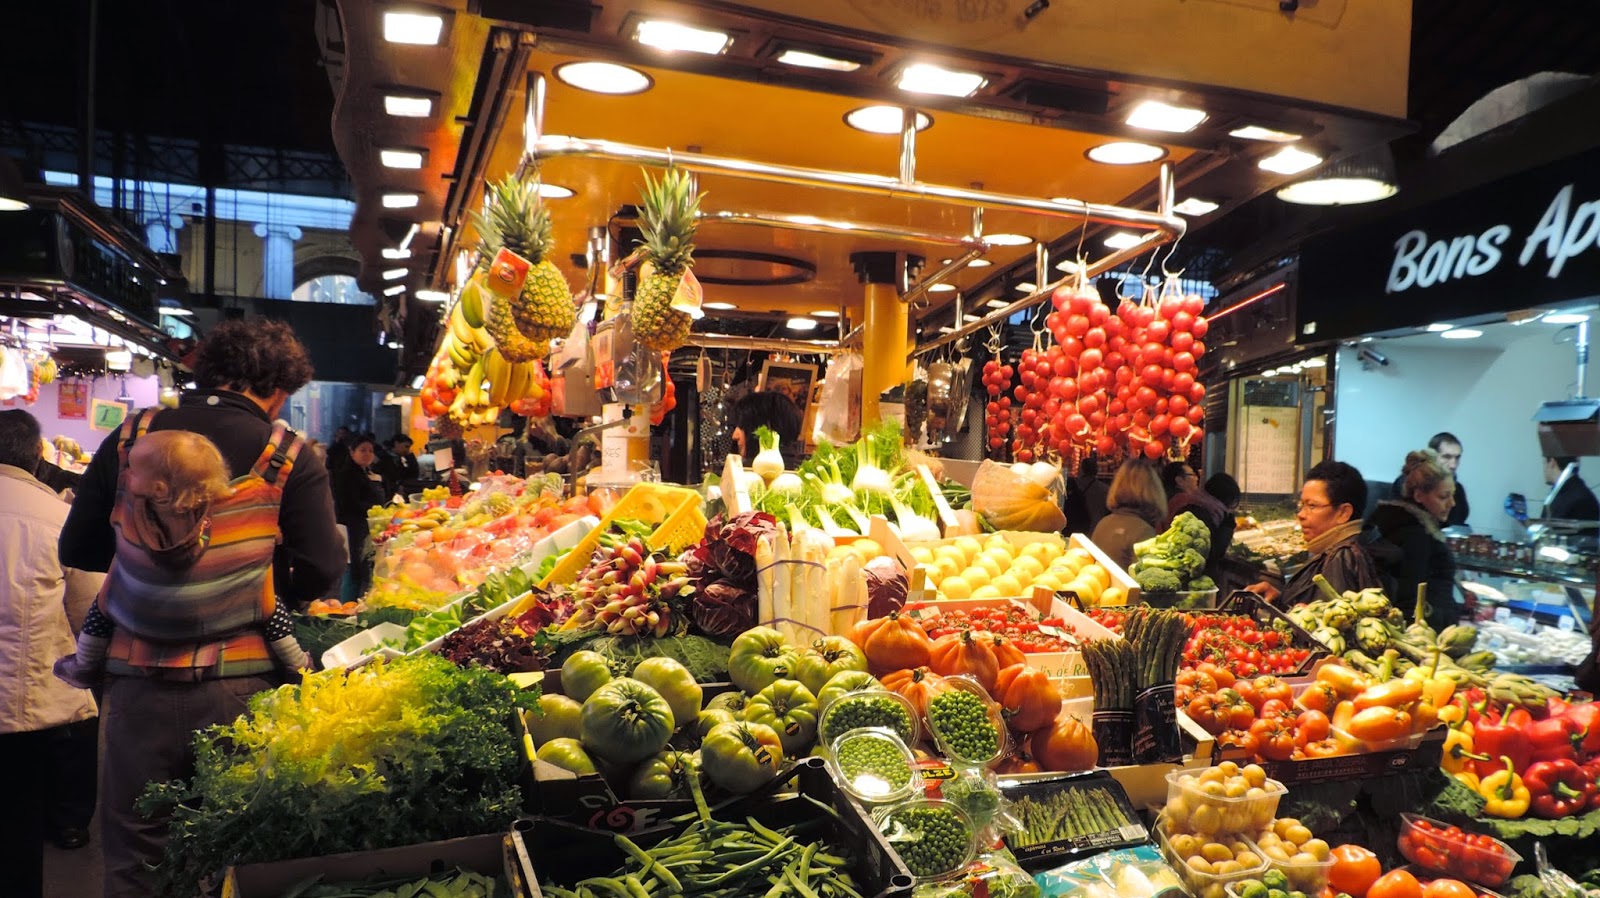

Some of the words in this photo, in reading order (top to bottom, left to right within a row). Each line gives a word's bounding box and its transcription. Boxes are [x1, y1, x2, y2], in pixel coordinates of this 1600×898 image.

[1385, 224, 1511, 294] Bons
[1518, 184, 1600, 279] Ap
[920, 768, 953, 779] ULZE
